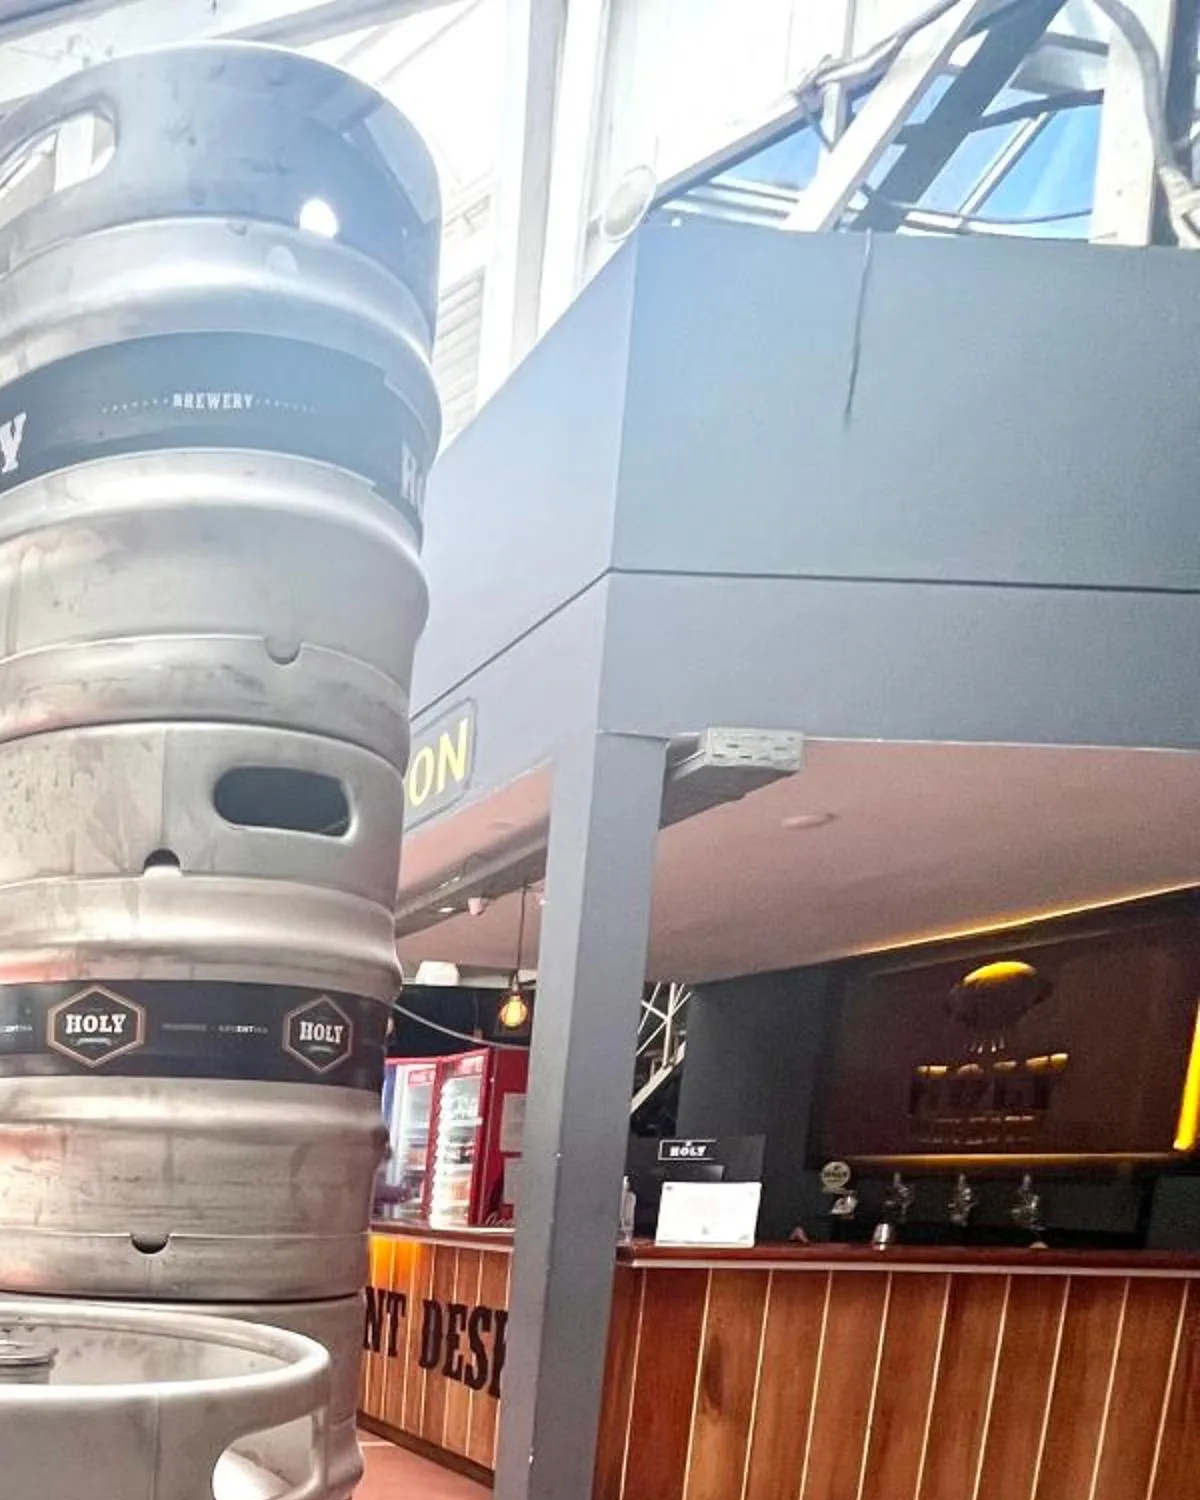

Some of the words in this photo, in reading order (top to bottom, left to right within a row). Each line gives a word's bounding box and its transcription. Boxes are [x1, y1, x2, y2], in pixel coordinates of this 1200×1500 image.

[173, 392, 253, 409] BREWERY
[65, 1013, 127, 1034] HOLY
[300, 1020, 345, 1044] HOLY
[670, 1145, 707, 1157] HOLY
